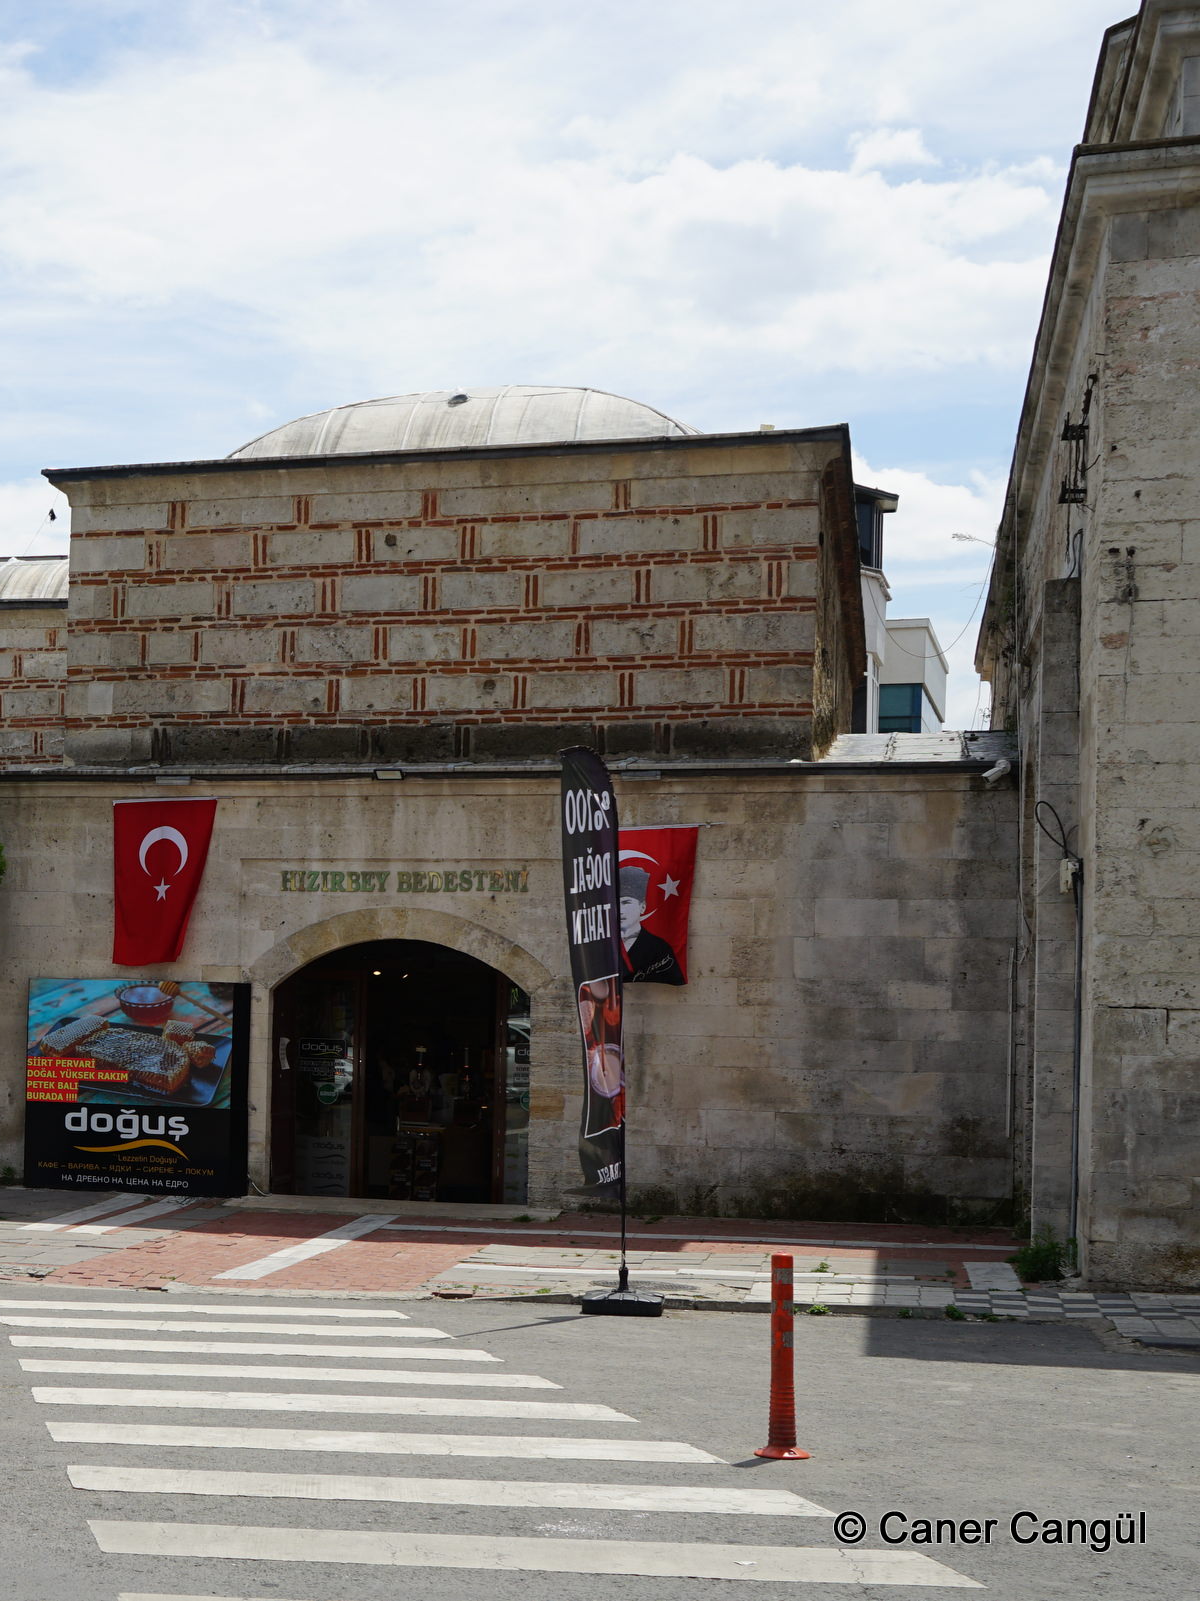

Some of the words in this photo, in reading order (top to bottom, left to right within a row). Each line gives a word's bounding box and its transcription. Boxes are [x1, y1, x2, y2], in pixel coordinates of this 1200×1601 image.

[280, 870, 390, 892] HIZIRBEY
[396, 865, 529, 893] BEDESTENİ
[302, 1042, 343, 1053] doğuş
[27, 1057, 53, 1067] SİİRT
[56, 1059, 96, 1069] PERVARİ
[27, 1068, 57, 1078] DOĞAL
[60, 1069, 95, 1080] YÜKSEK
[98, 1072, 128, 1081] RAKIM
[27, 1081, 55, 1090] PETEK
[57, 1082, 79, 1090] BALI
[26, 1092, 63, 1101] BURADA
[65, 1107, 189, 1141] doğuş
[61, 1173, 73, 1181] НА
[76, 1174, 110, 1184] ДРЕБНО
[112, 1176, 124, 1184] НА
[126, 1178, 149, 1186] ЦЕНА
[152, 1179, 164, 1187] НА
[165, 1180, 189, 1188] ЕДРО
